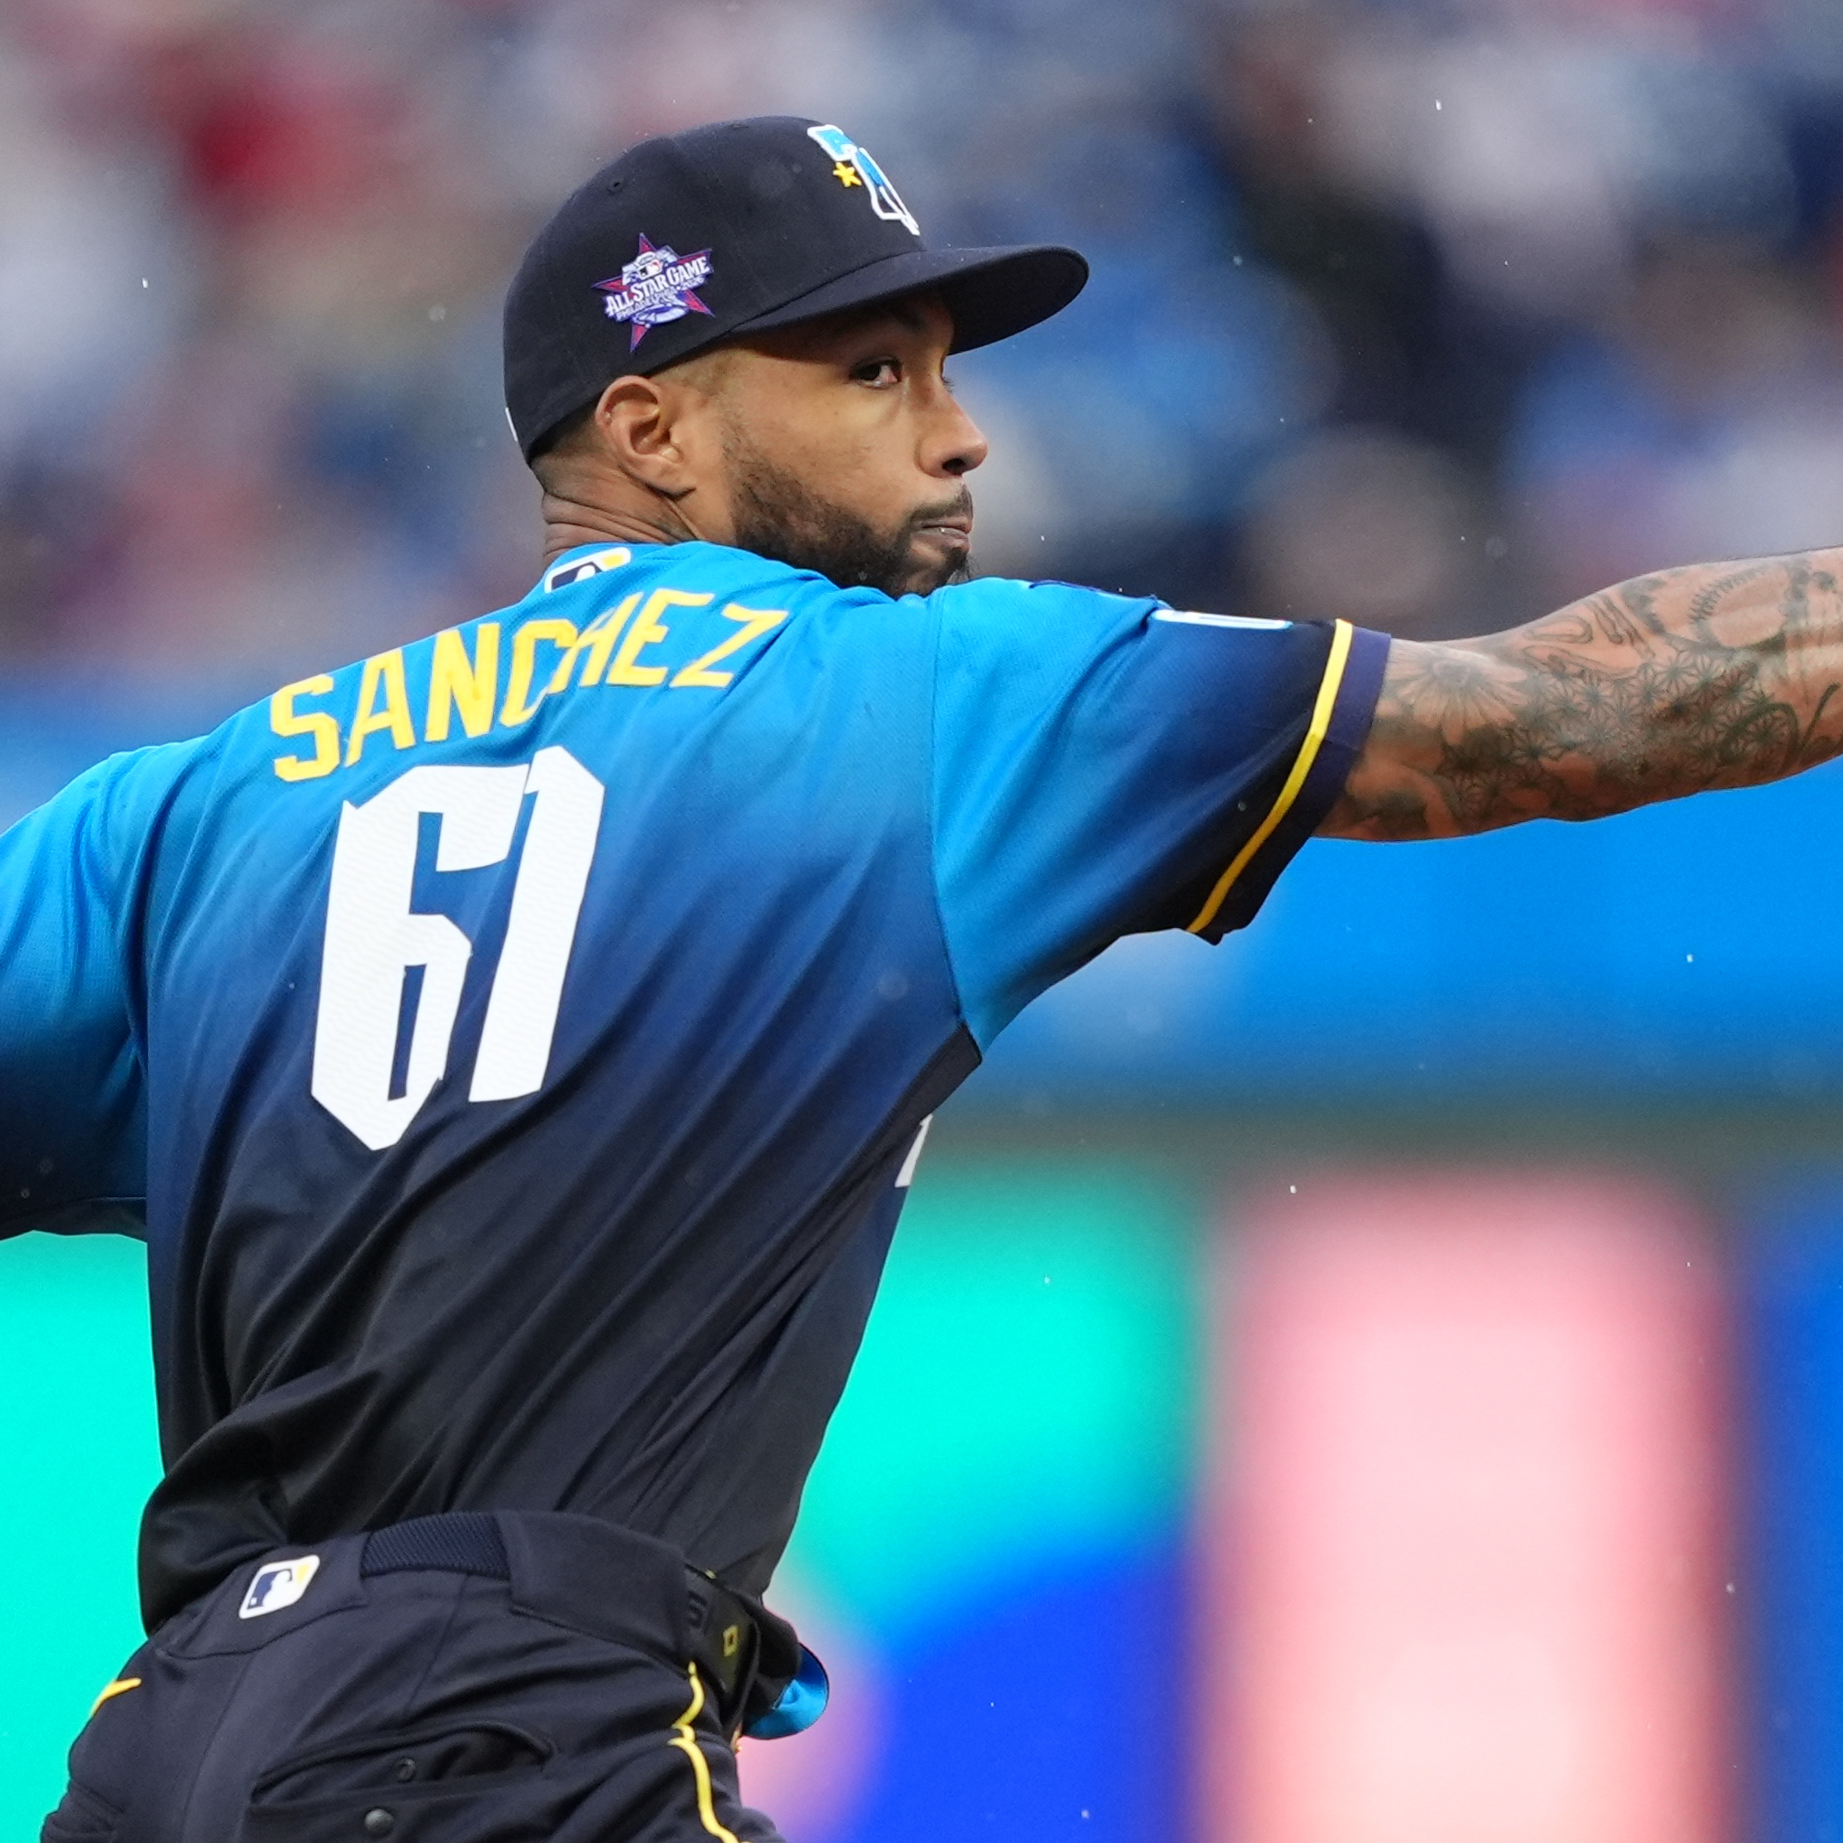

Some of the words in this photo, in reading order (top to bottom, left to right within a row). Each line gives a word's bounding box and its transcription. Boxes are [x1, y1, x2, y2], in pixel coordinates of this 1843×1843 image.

[605, 291, 634, 318] ALL
[630, 274, 667, 302] STAR
[666, 256, 710, 286] GAME
[270, 588, 789, 782] SANCHEZ
[311, 745, 606, 1152] 61
